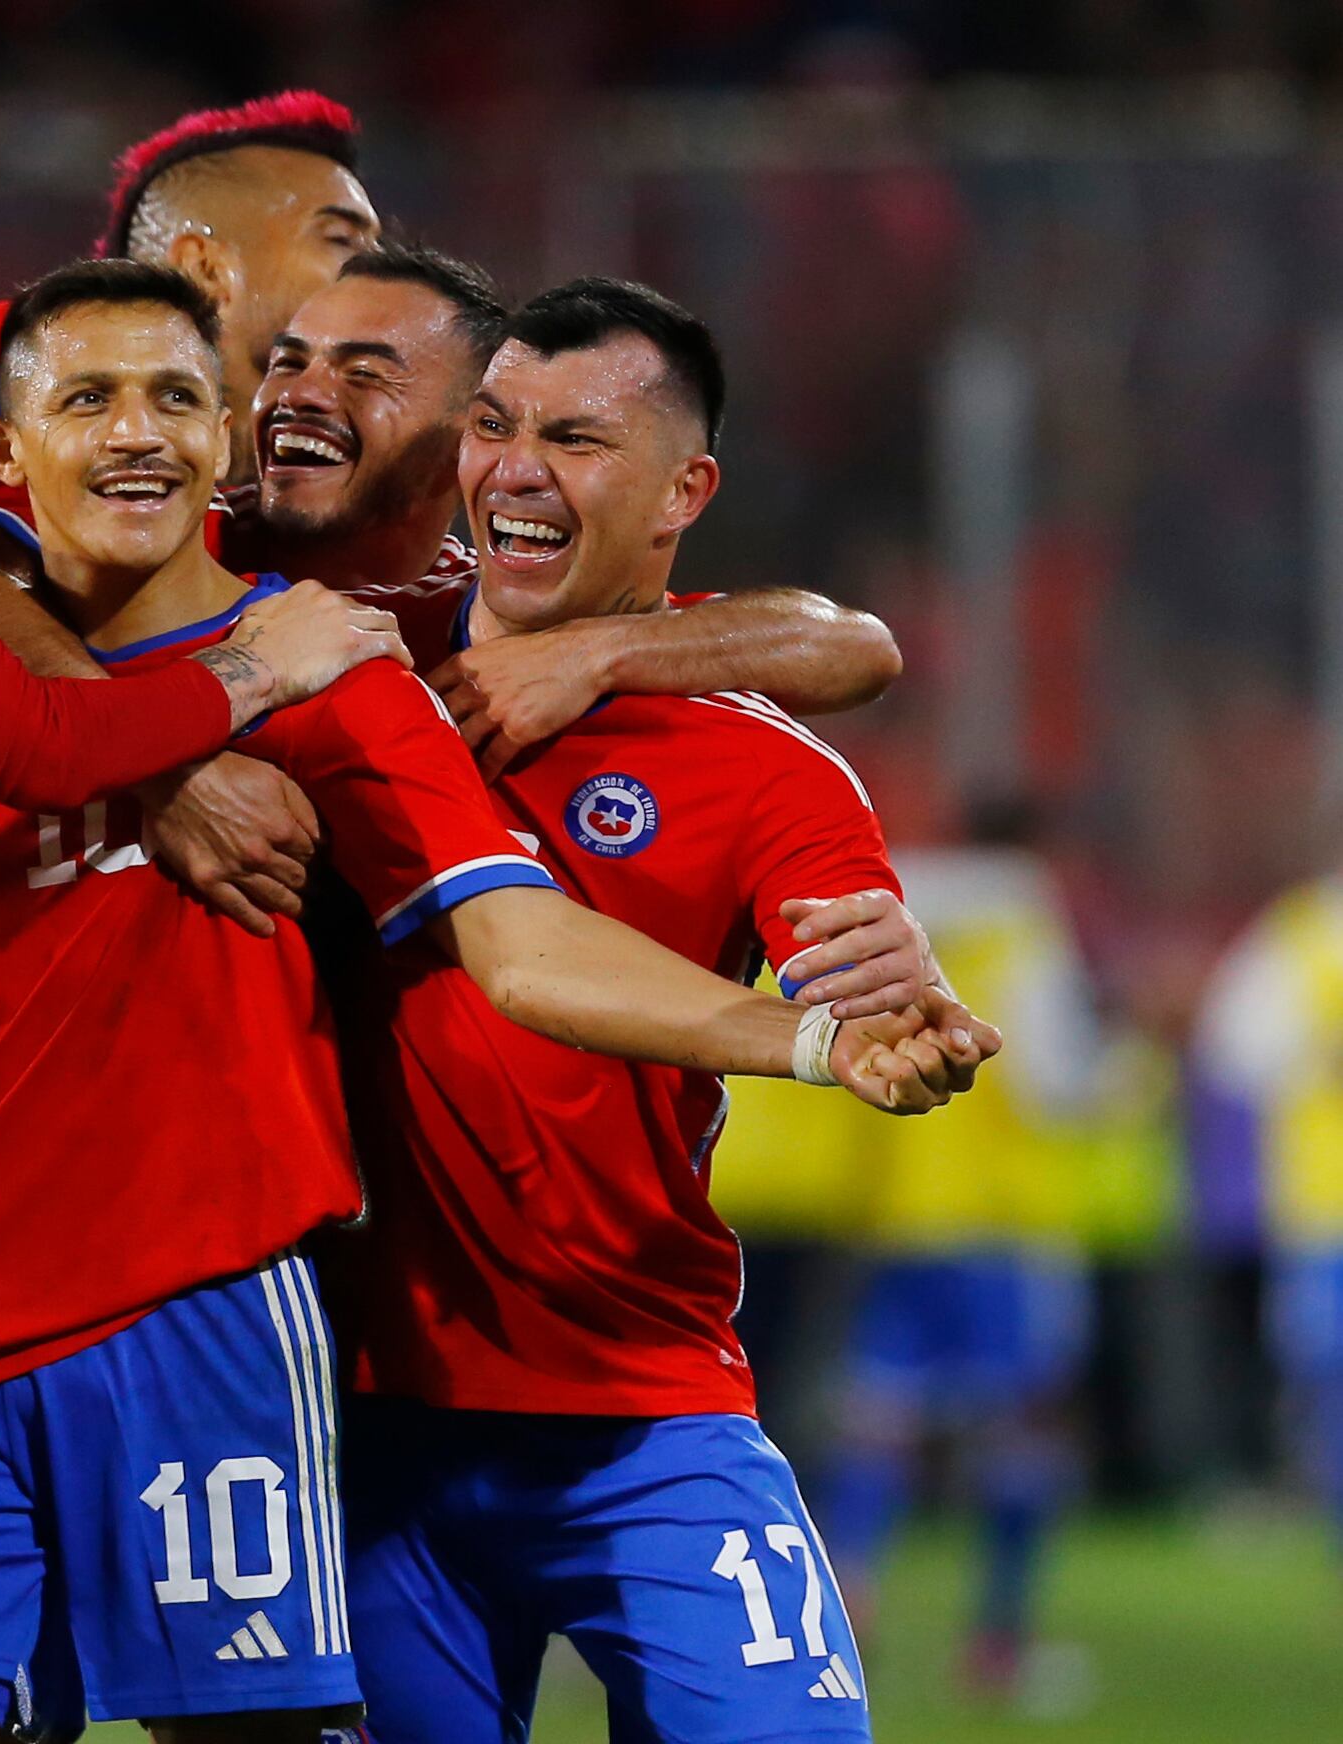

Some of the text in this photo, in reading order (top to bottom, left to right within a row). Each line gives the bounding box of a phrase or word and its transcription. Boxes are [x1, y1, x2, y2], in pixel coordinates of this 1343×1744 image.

[595, 844, 624, 855] CHILE
[641, 798, 656, 830] FUTBOL
[139, 1456, 291, 1604] 10
[710, 1523, 829, 1667] 17
